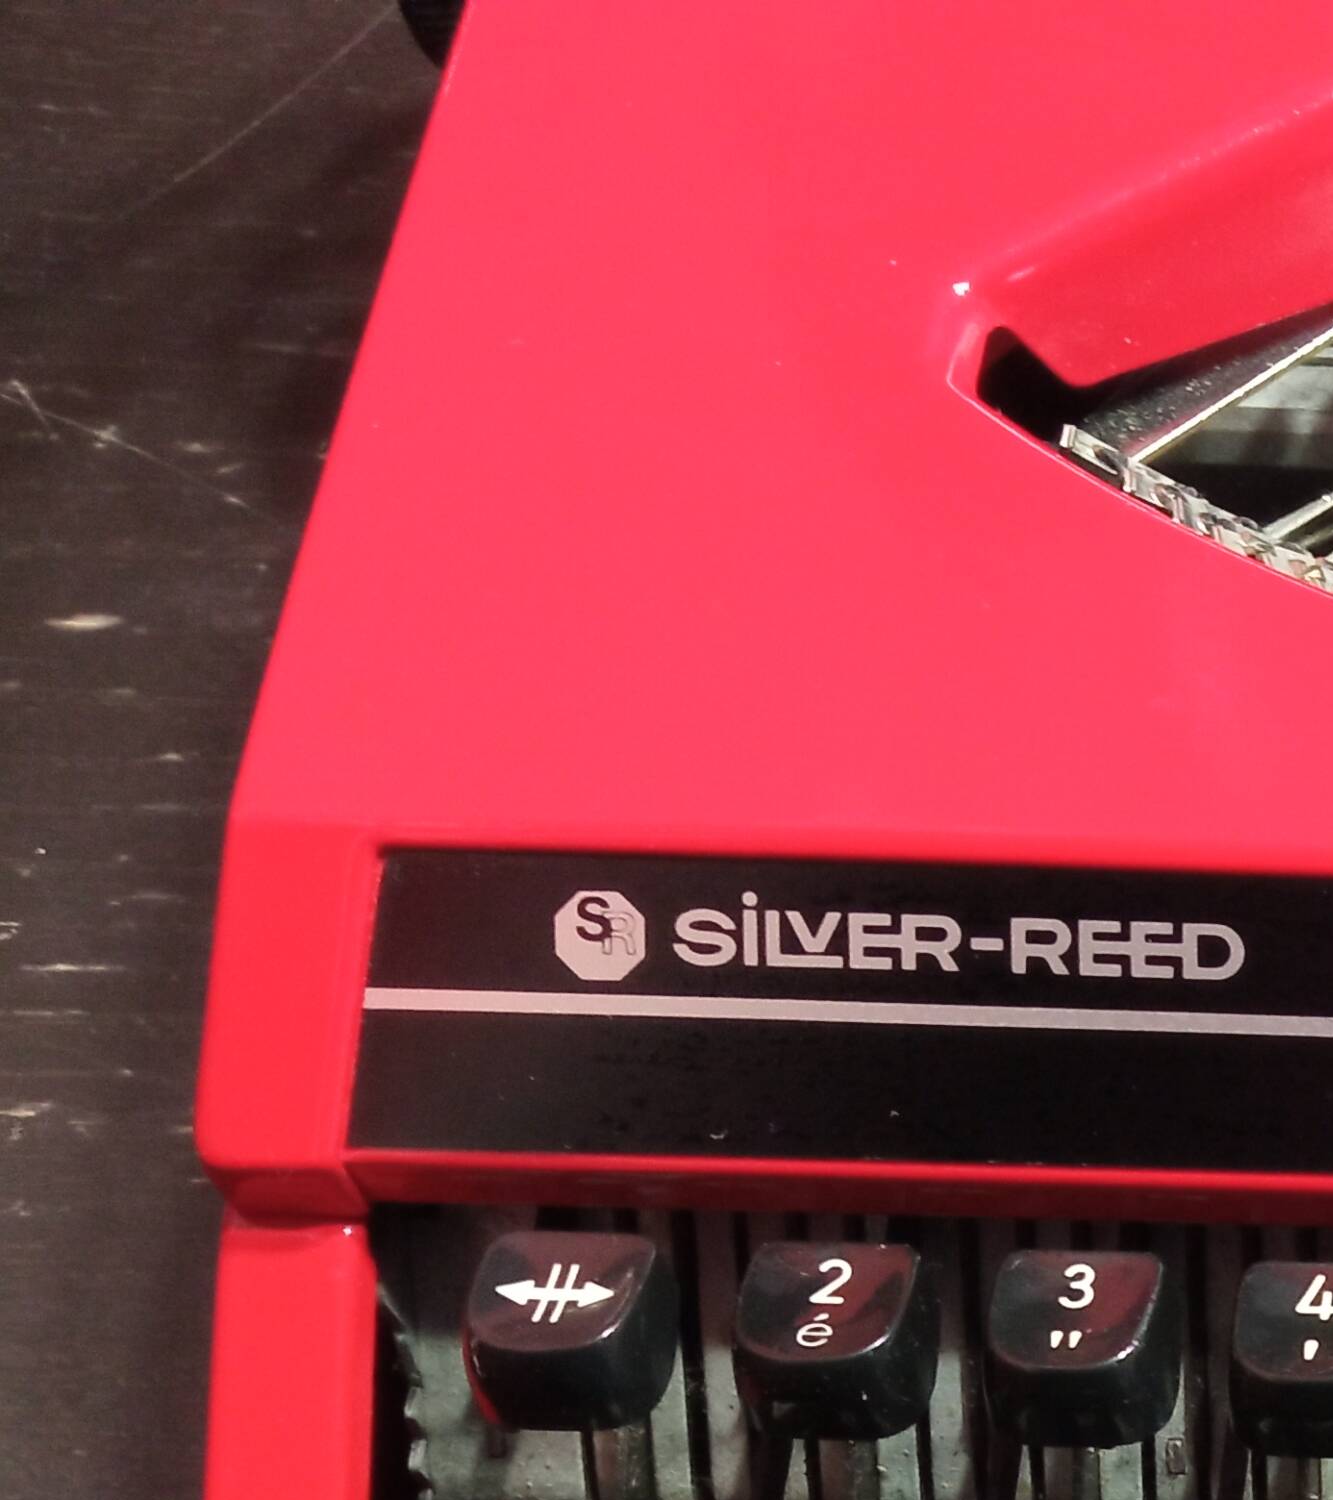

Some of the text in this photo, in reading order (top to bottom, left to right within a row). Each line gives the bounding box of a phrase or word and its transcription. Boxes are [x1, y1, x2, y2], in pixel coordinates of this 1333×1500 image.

[809, 1259, 852, 1304] 2
[1058, 1264, 1095, 1309] 3
[796, 1313, 833, 1348] é
